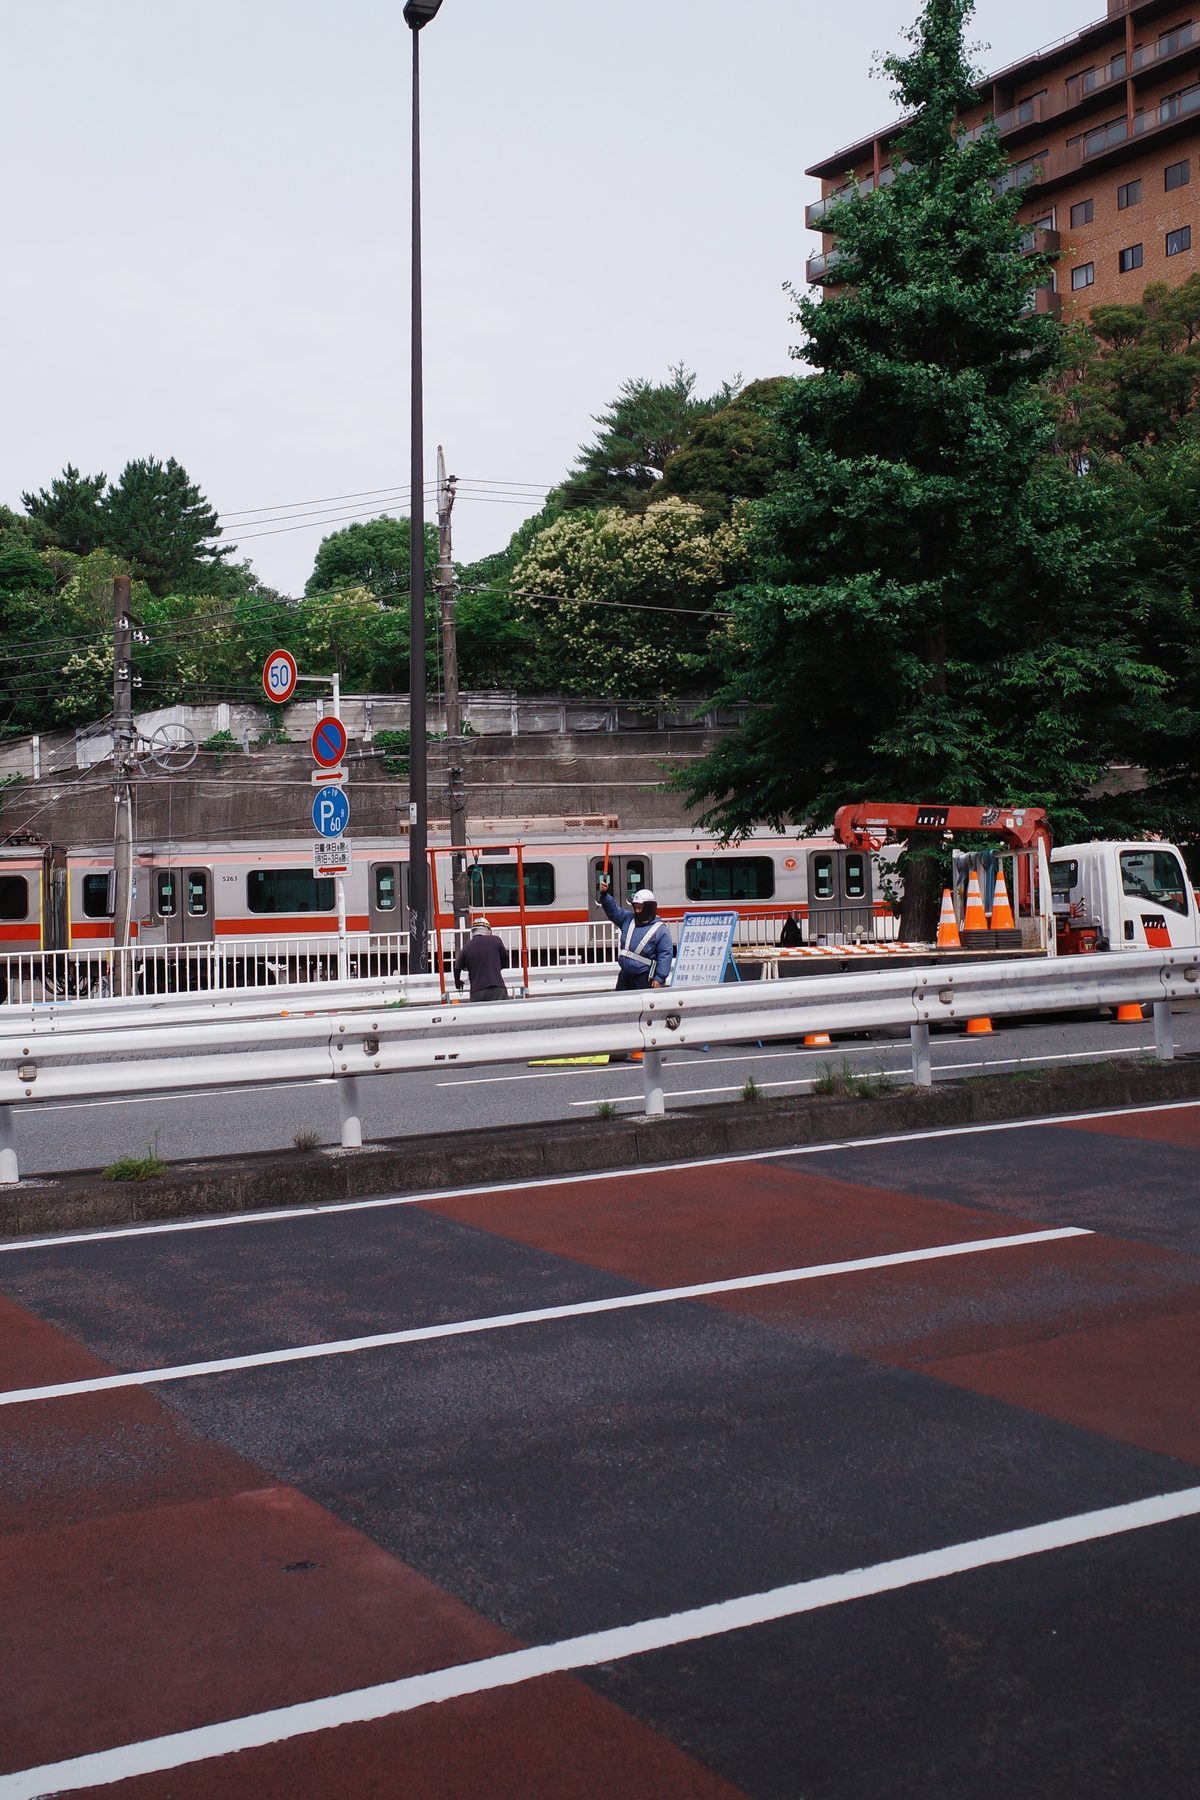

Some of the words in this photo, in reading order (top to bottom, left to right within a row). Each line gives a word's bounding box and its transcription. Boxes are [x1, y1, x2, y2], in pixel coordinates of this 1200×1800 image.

[271, 665, 288, 688] 50
[320, 800, 335, 833] P
[330, 817, 341, 832] 60
[683, 946, 723, 957] 行っています
